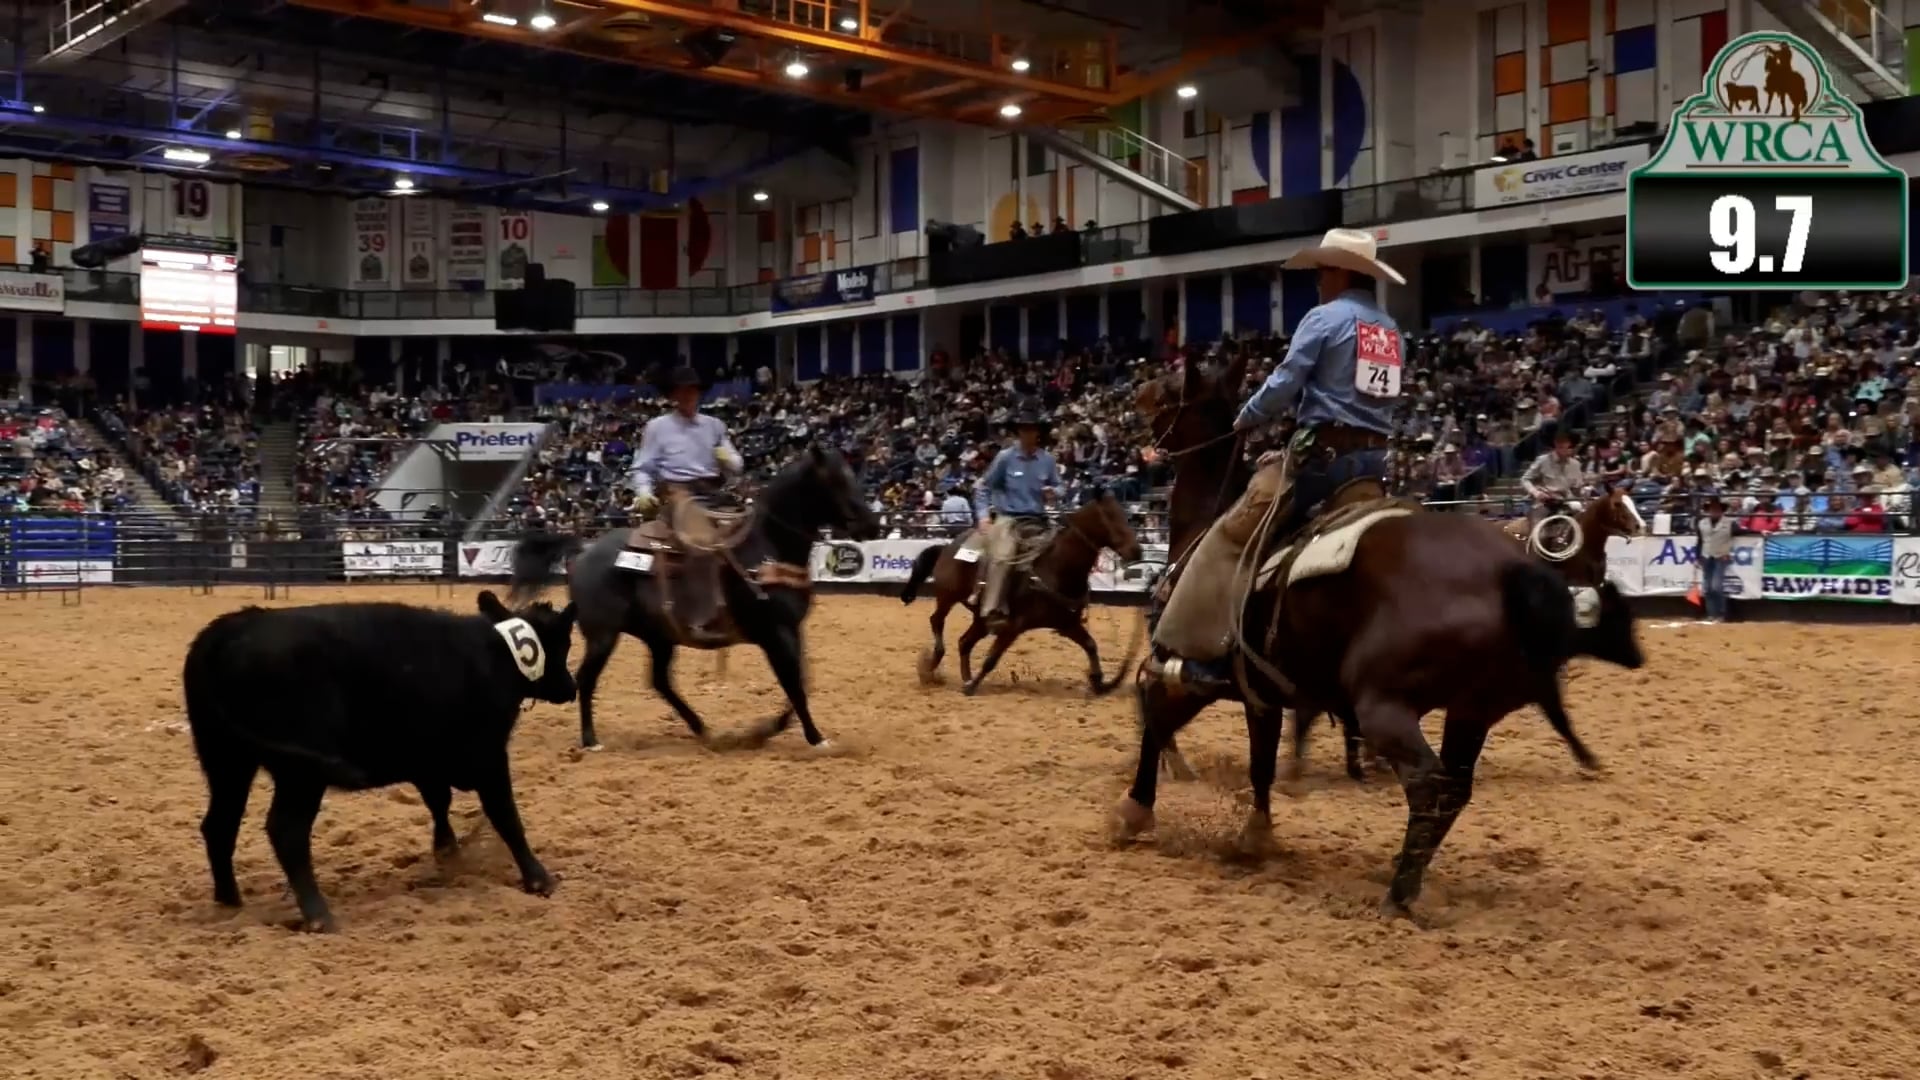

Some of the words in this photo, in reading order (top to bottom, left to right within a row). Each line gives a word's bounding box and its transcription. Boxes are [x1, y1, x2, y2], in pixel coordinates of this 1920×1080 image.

[1523, 169, 1563, 184] Civic
[1566, 160, 1627, 178] Center
[172, 181, 210, 219] 19
[501, 218, 529, 241] 10
[358, 233, 385, 253] 39
[1361, 339, 1397, 359] WRCA
[1368, 366, 1390, 387] 74
[456, 430, 535, 447] Priefert
[1761, 576, 1891, 596] RAWHIDE
[508, 623, 540, 668] 5
